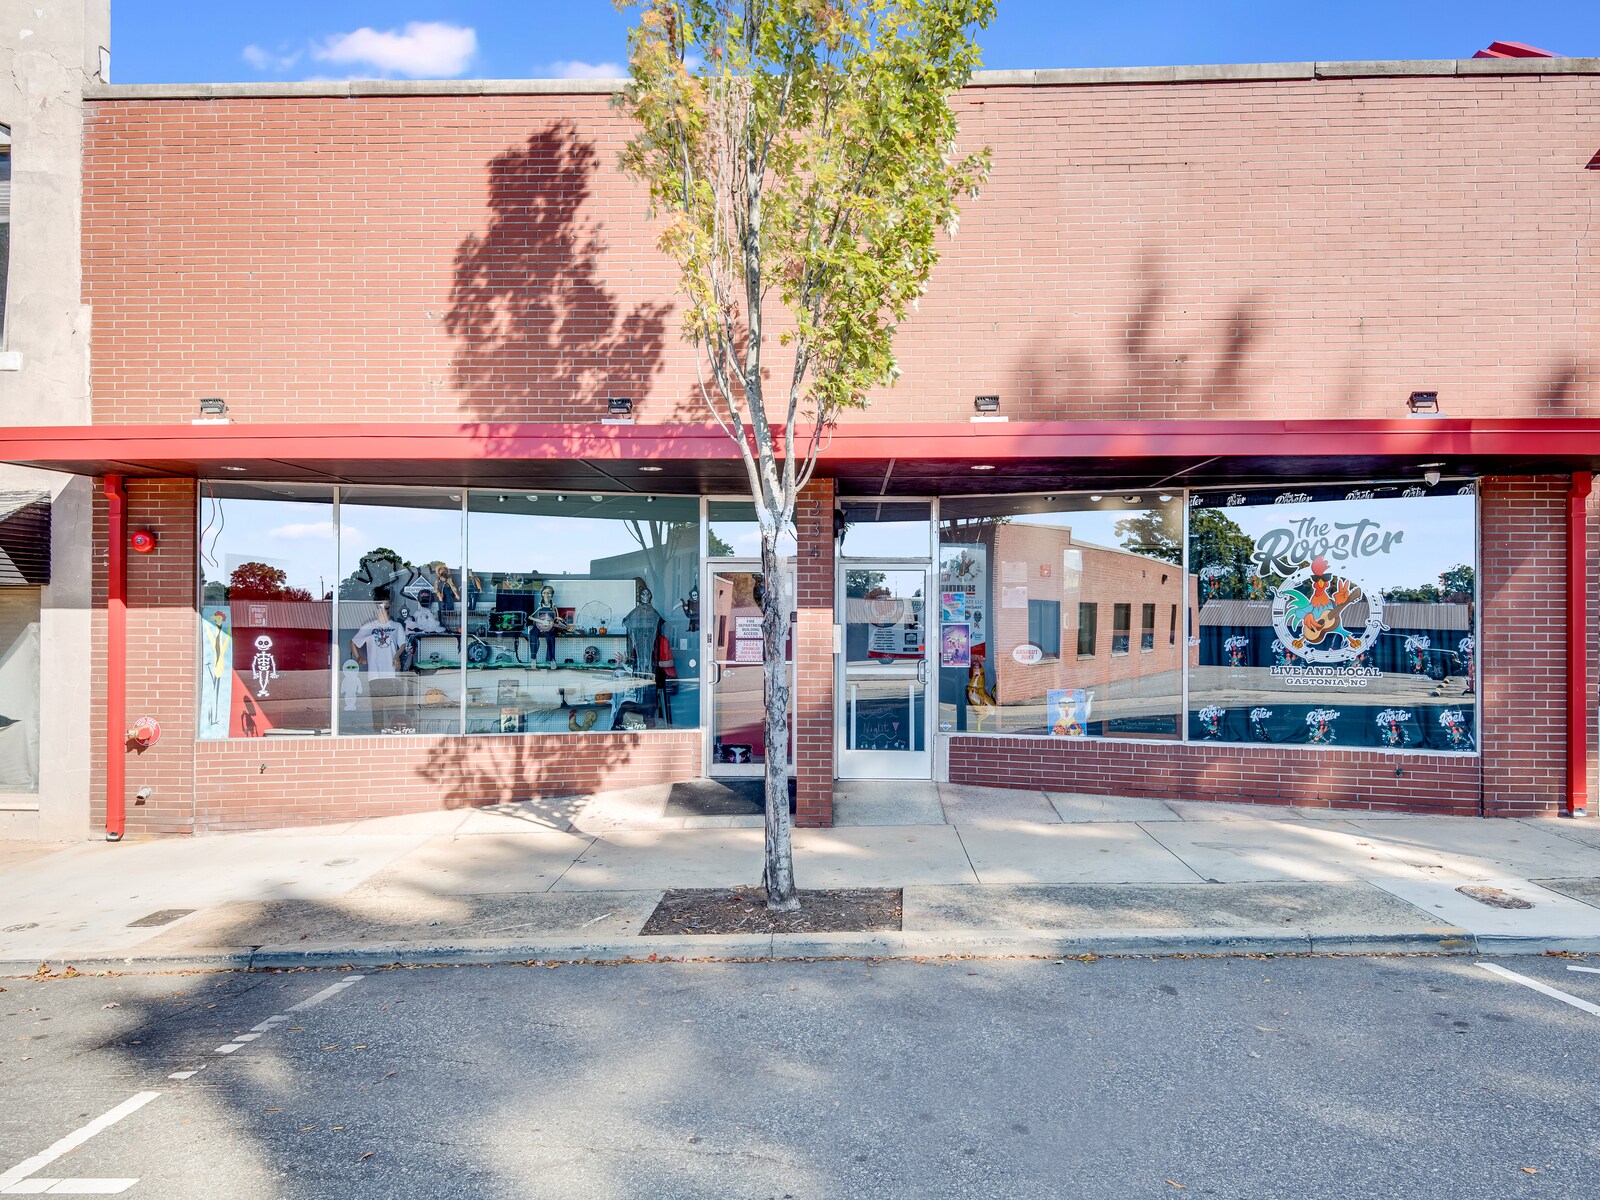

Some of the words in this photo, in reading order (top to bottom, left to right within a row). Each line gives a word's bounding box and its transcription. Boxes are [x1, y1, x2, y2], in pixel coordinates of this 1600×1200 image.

[809, 500, 820, 560] 334
[1289, 516, 1331, 539] The
[1252, 518, 1404, 577] Rooster
[1270, 666, 1301, 676] LIVE
[1305, 667, 1334, 677] AND
[1336, 667, 1382, 678] LOCAL
[1285, 677, 1348, 687] GASTONIA,
[1349, 678, 1367, 686] NC
[863, 722, 890, 737] Night
